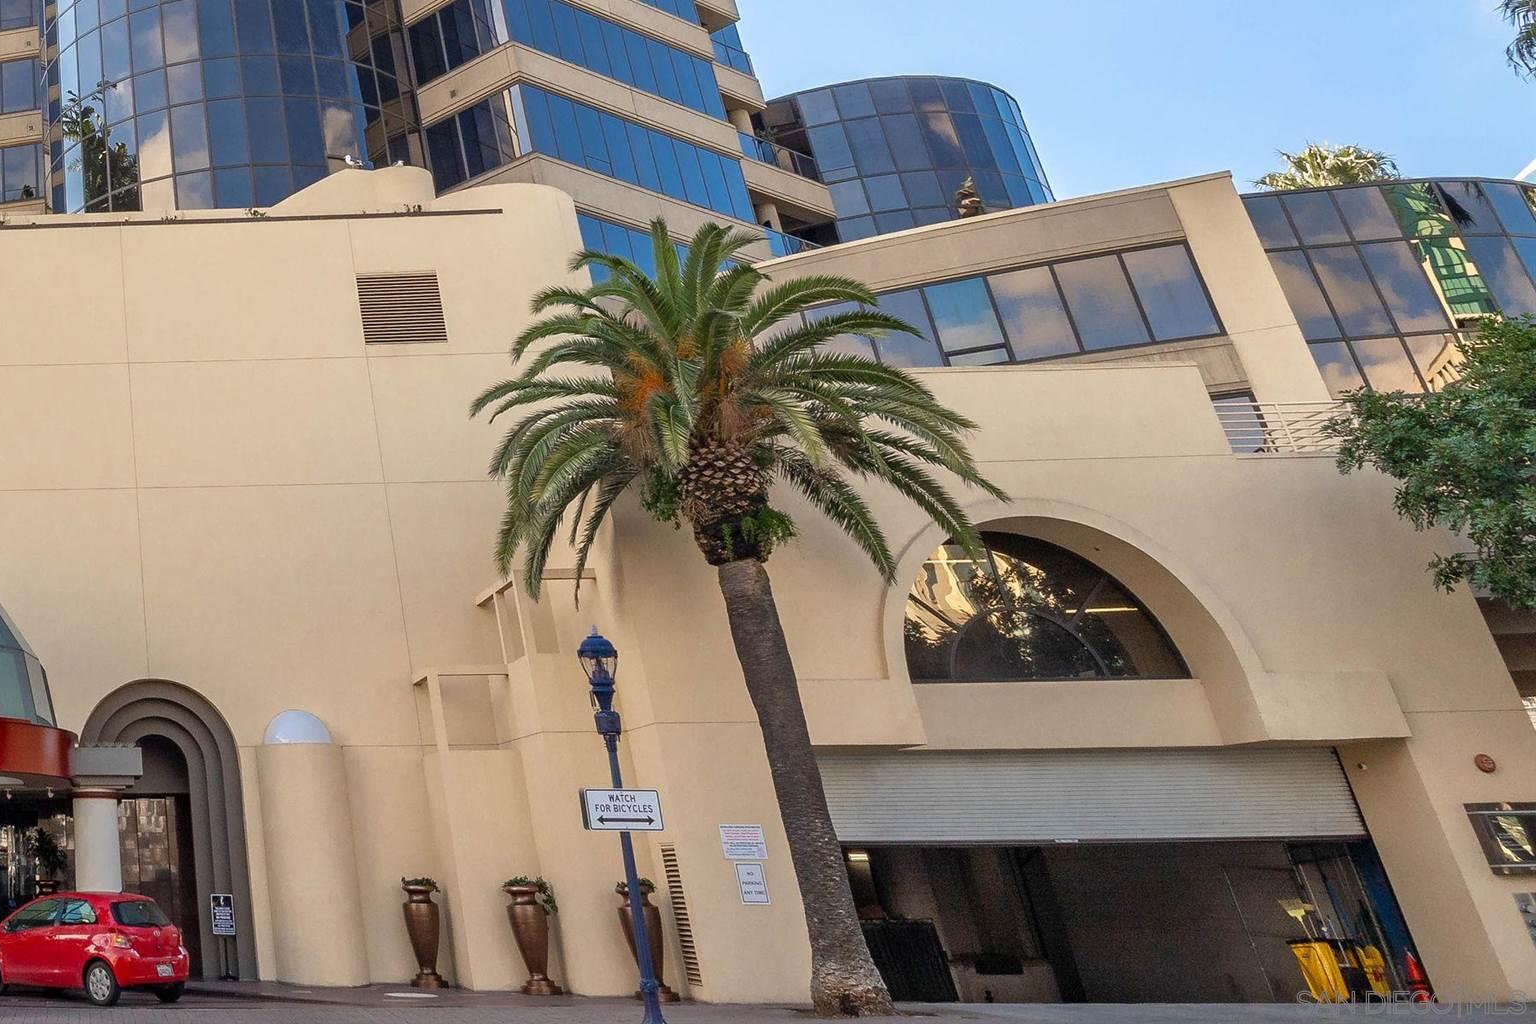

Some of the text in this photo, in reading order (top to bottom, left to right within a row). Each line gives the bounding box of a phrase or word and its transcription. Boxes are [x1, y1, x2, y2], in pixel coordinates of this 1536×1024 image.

[608, 794, 636, 803] WATCH
[595, 804, 654, 813] FOR BICYCLES
